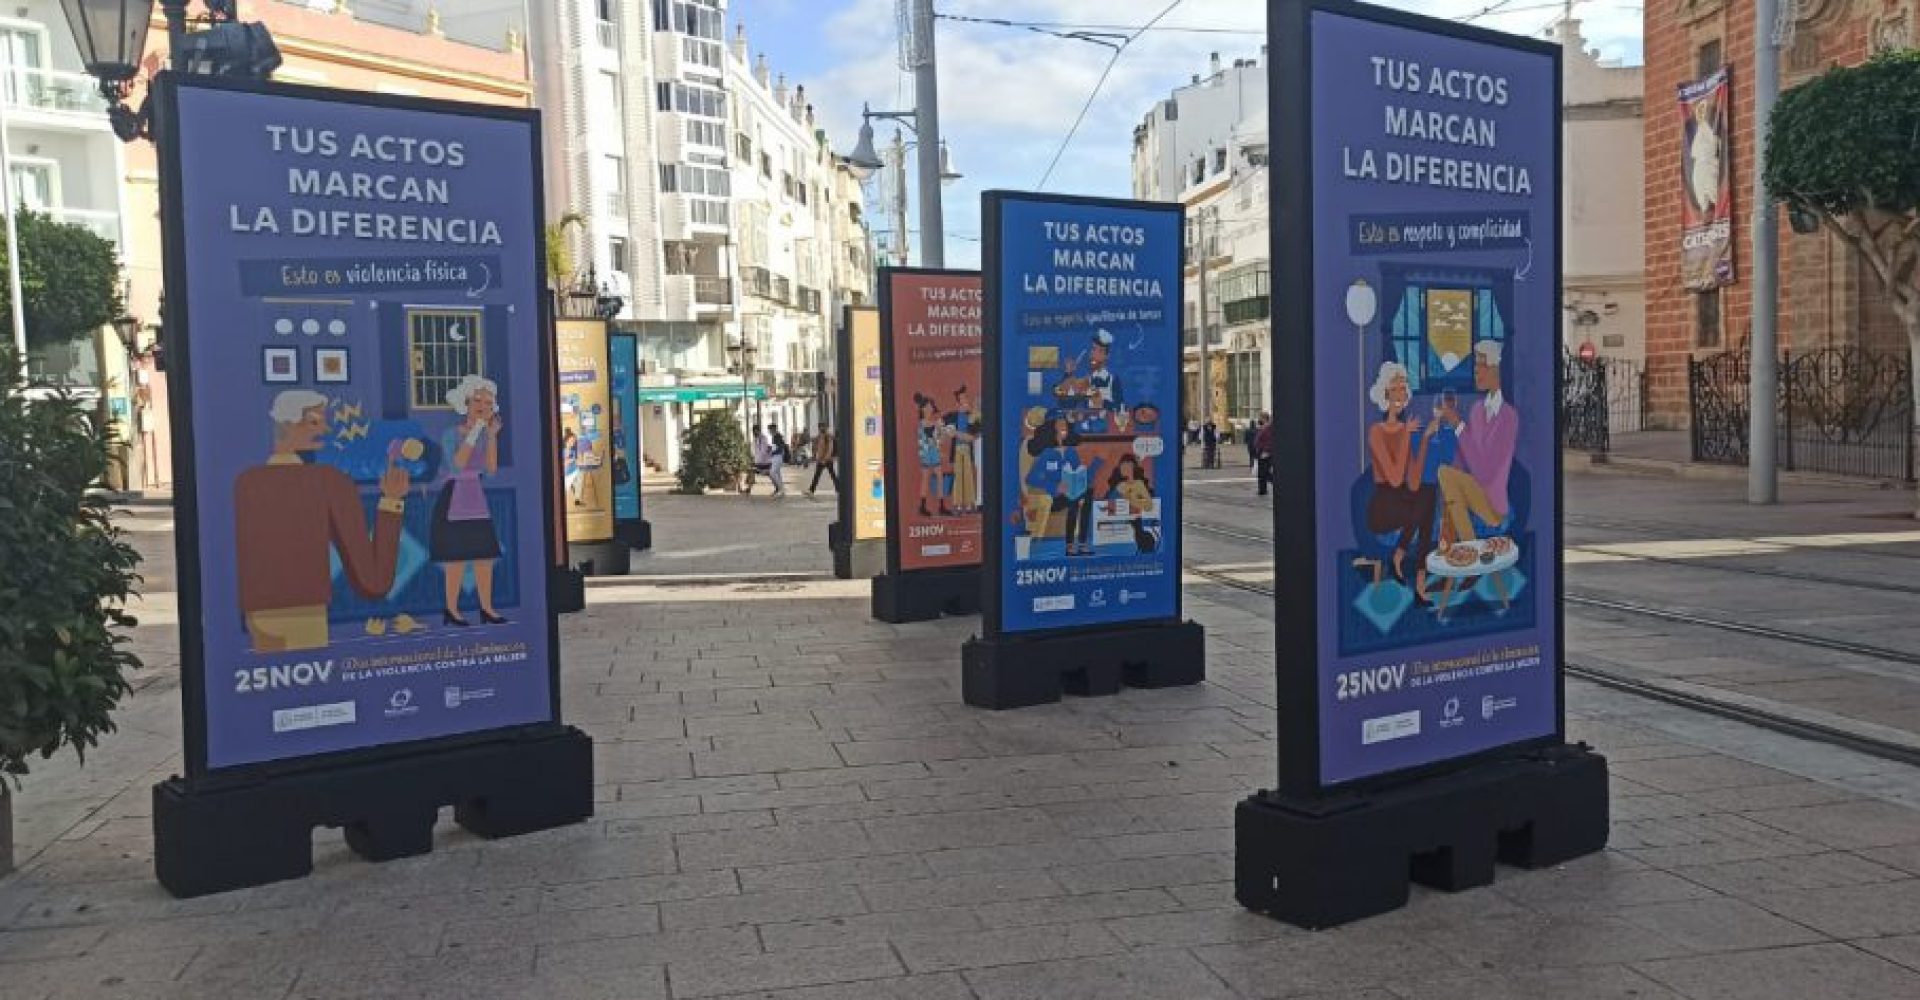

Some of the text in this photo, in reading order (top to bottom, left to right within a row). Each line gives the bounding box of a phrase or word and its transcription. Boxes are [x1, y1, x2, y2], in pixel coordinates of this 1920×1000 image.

[1371, 56, 1508, 105] TUS ACTOS
[1384, 105, 1496, 147] MARCAN
[265, 125, 465, 166] TUS ACTOS
[289, 168, 449, 204] MARCAN
[1344, 147, 1532, 194] LA DIFERENCIA
[230, 204, 502, 244] LA DIFERENCIA
[1044, 221, 1145, 246] TUS ACTOS
[1359, 221, 1384, 243] Esto
[1403, 222, 1443, 249] respeto
[1447, 225, 1456, 249] y
[1458, 217, 1521, 247] complicidad
[281, 264, 318, 286] Esto
[325, 270, 341, 284] es
[347, 262, 422, 284] violencia
[1054, 248, 1135, 271] MARCAN
[920, 287, 981, 302] TUS ACTO
[1023, 273, 1163, 298] LA DIFERENCIA
[908, 322, 981, 337] LA DIFEREN
[1016, 566, 1067, 586] 25NOV
[234, 659, 334, 692] 25NOV
[1336, 663, 1406, 700] 25NOV
